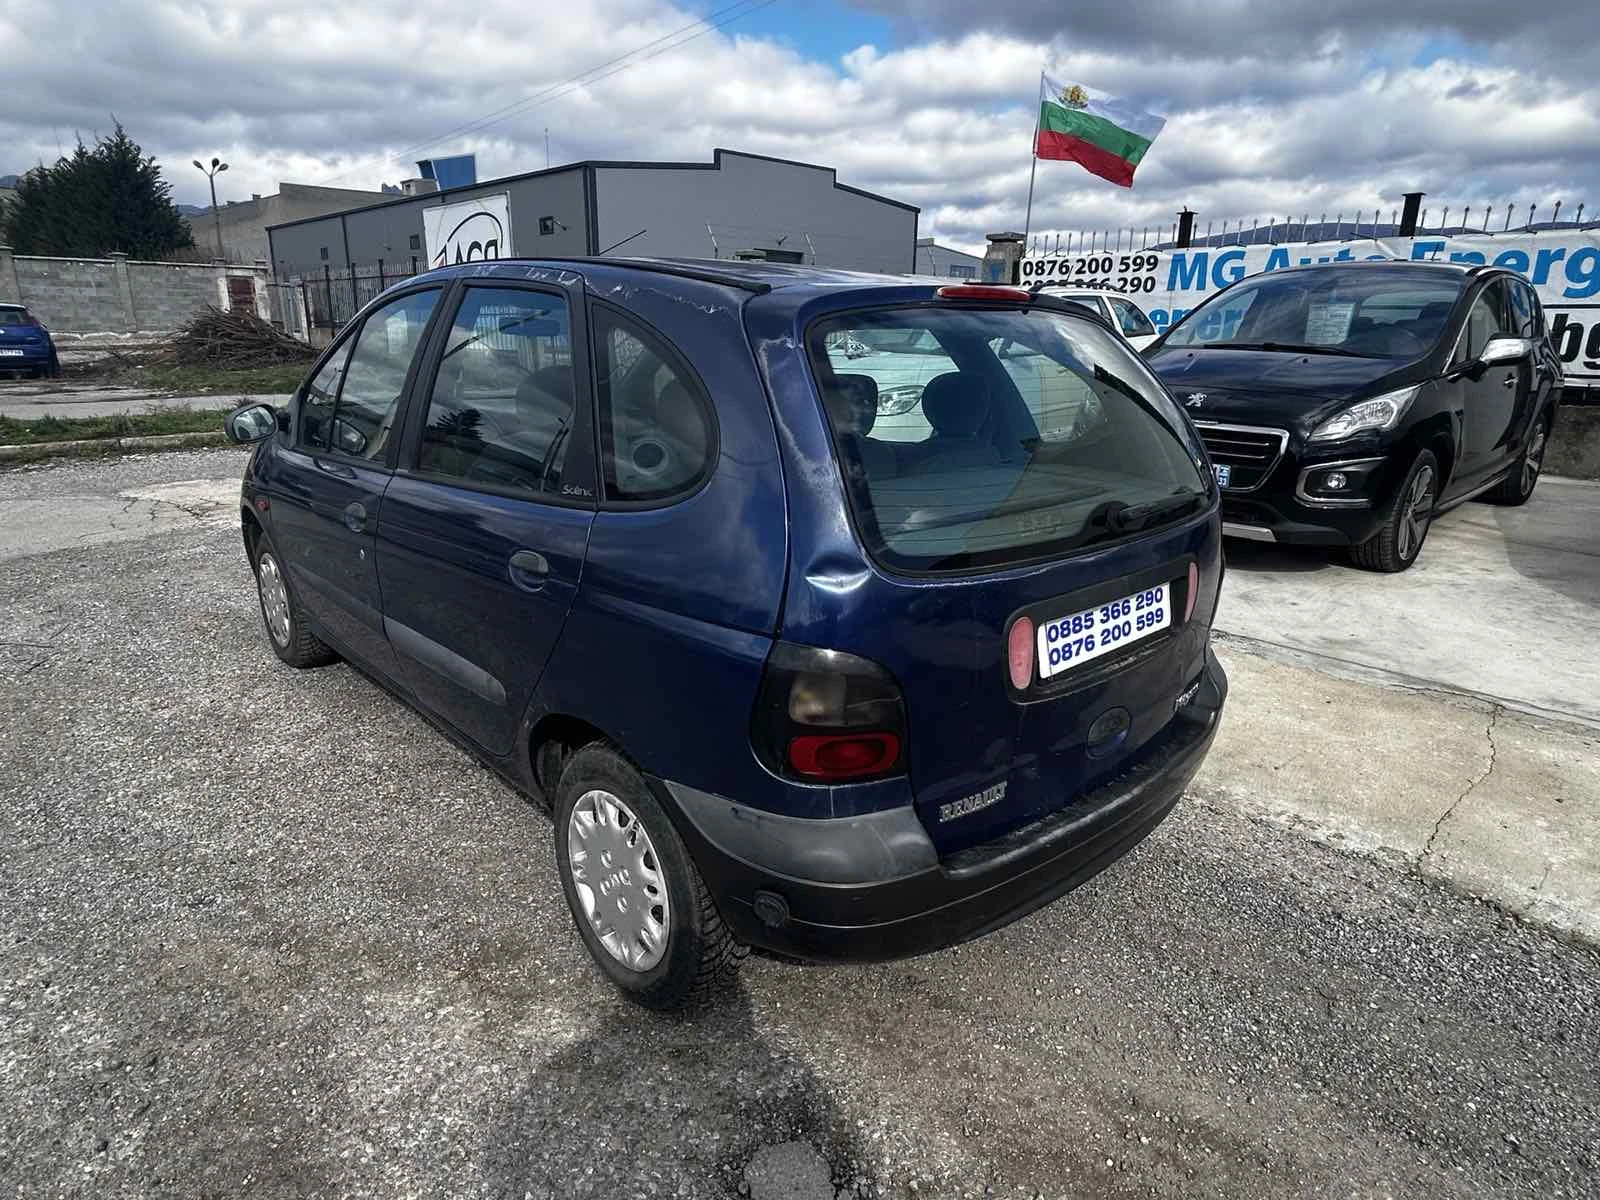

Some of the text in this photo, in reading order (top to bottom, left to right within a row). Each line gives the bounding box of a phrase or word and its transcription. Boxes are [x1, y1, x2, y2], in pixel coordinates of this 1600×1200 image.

[1022, 254, 1159, 276] 0876 200 599
[1117, 275, 1156, 293] 290
[1166, 249, 1247, 291] MG
[1047, 587, 1164, 643] 0885 366 290
[1049, 607, 1164, 666] 0876 200 599
[939, 781, 1008, 822] RENAULT
